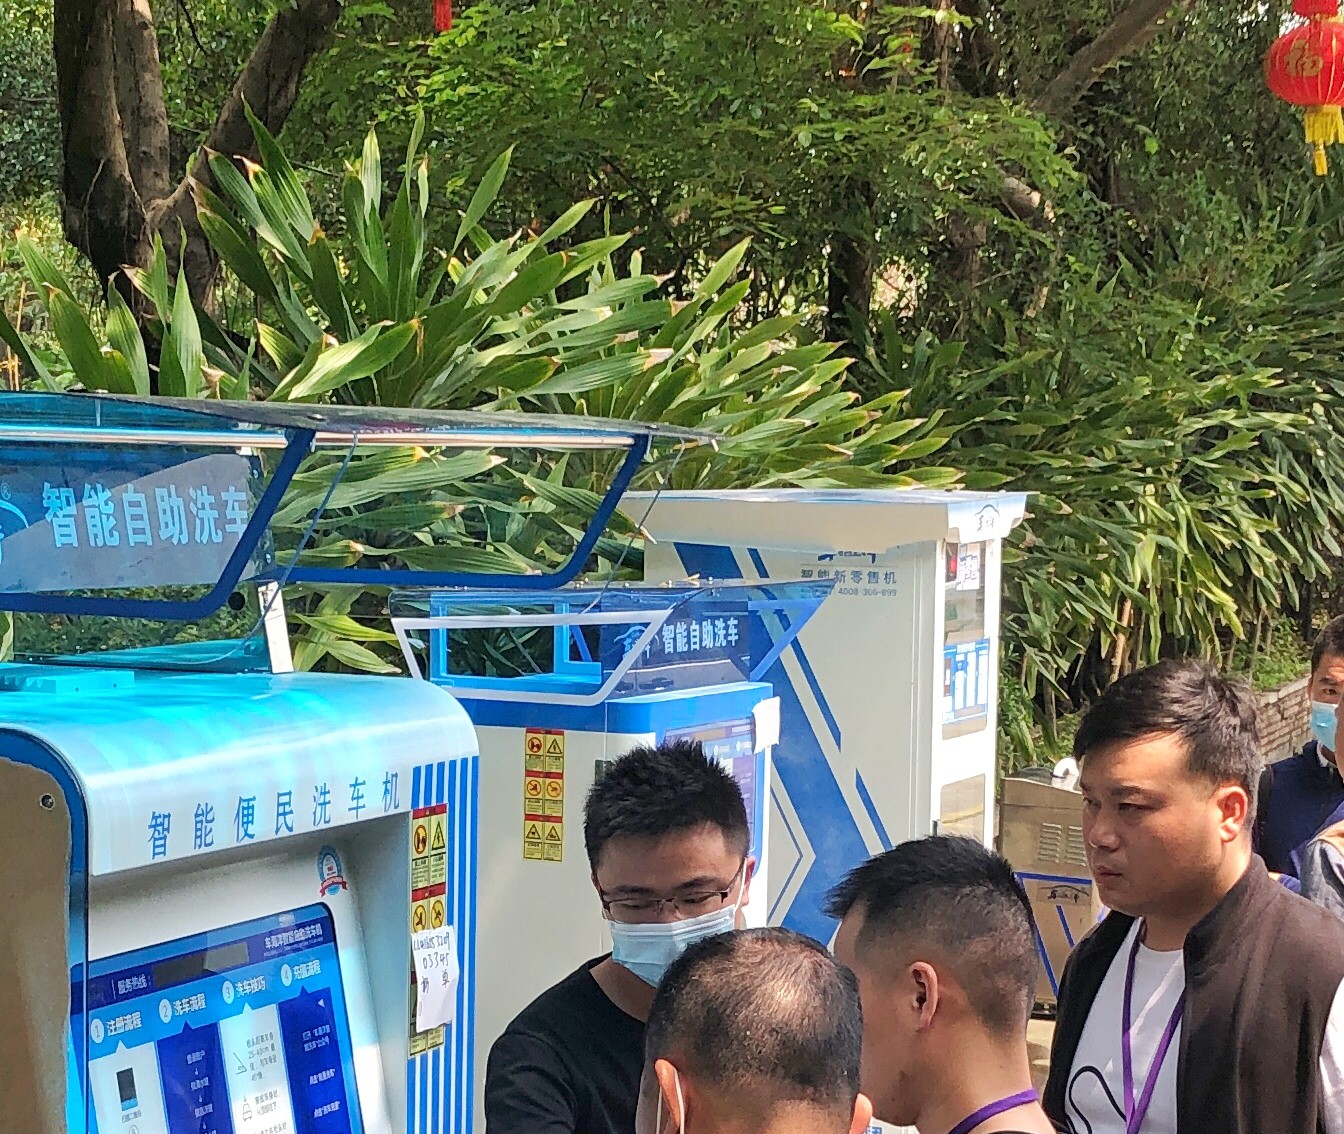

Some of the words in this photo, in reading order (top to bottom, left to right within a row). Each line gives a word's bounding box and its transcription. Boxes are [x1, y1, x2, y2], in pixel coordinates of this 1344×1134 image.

[42, 481, 248, 549] 智能自助洗车
[800, 568, 897, 584] 智能新零售机
[662, 616, 739, 655] 智能自助洗车
[147, 770, 400, 860] 智能便民洗车机
[235, 975, 267, 998] 洗车技巧
[173, 992, 206, 1017] 洗车流程
[105, 1011, 143, 1037] 注册流程
